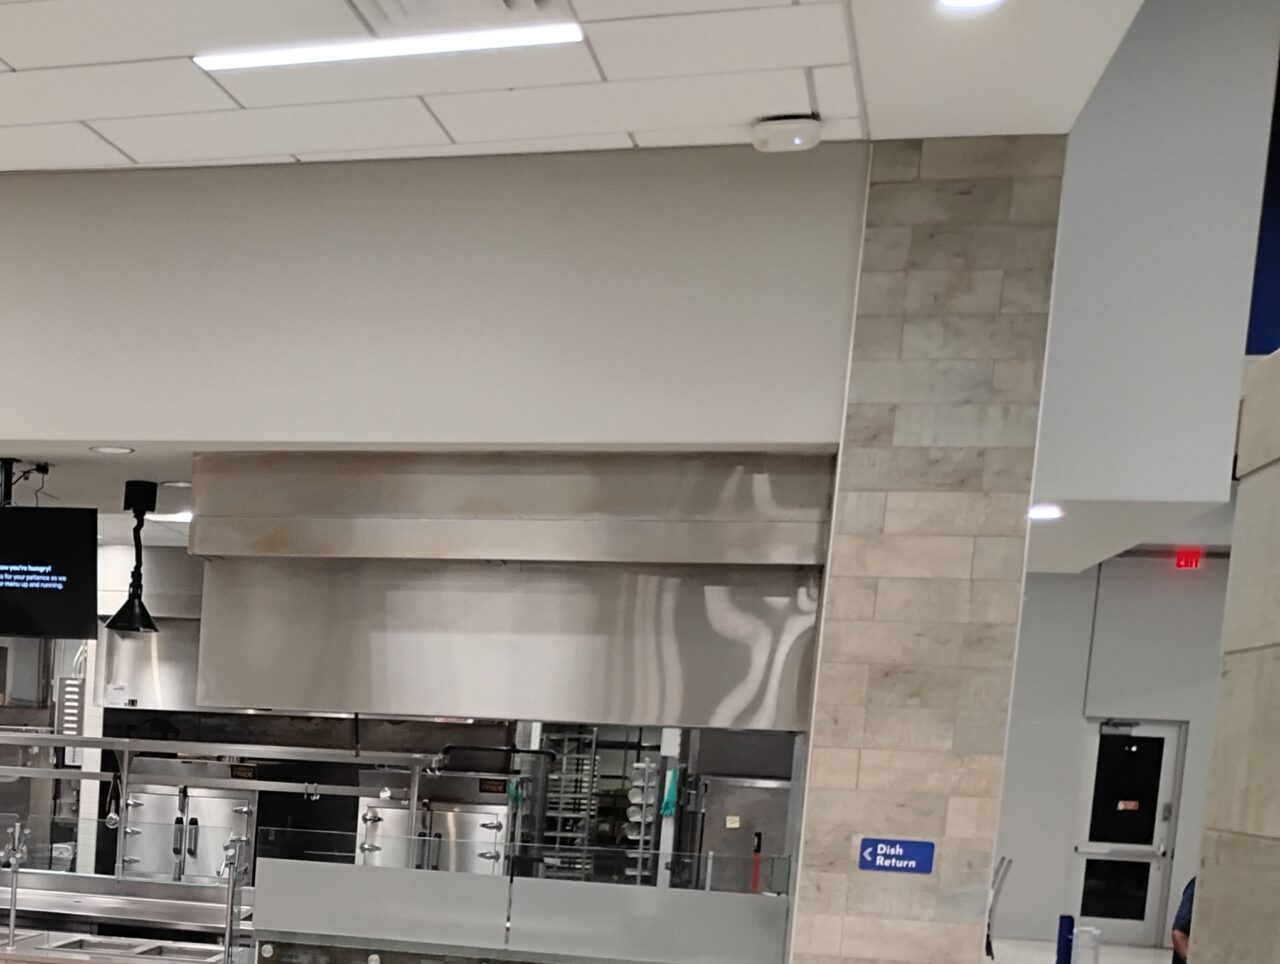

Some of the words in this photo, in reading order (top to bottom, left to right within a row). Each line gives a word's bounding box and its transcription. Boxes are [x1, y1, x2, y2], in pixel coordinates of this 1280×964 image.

[12, 574, 26, 582] your
[26, 574, 50, 582] patience
[877, 843, 904, 856] Dish
[875, 855, 916, 868] Return
